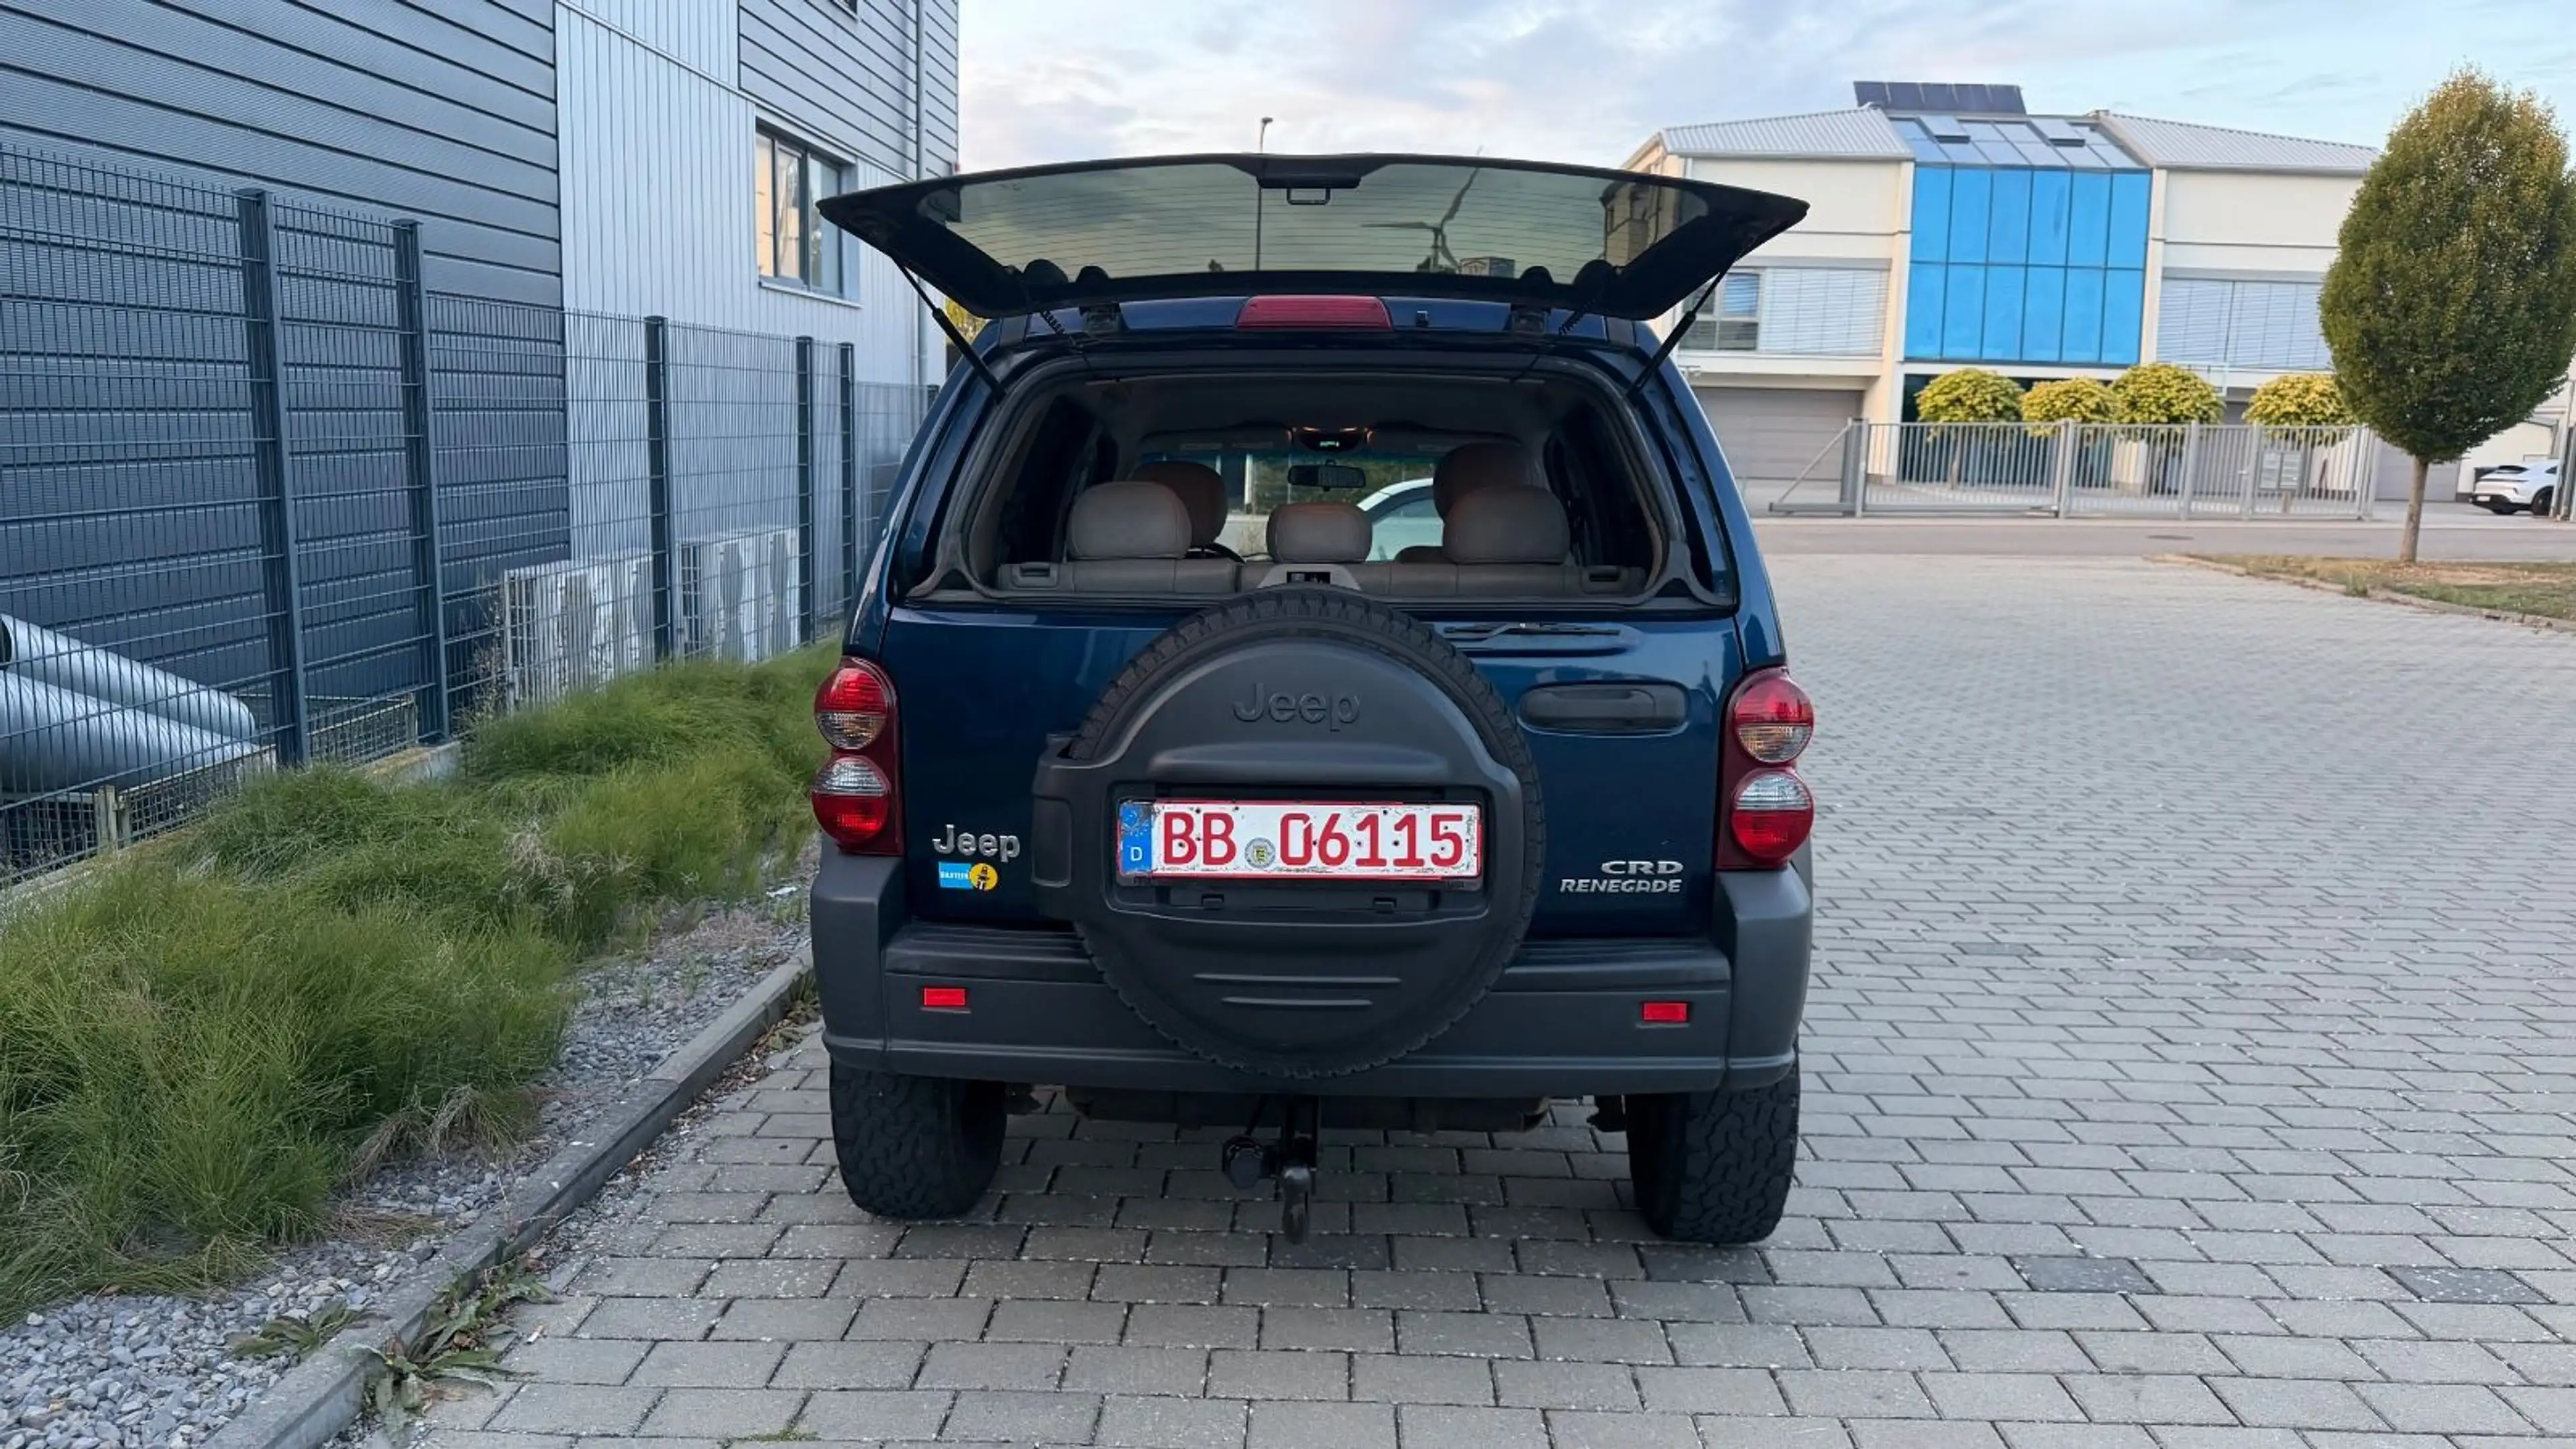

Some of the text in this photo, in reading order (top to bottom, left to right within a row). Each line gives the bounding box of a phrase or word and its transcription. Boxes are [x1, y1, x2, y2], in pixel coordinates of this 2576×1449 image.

[1233, 682, 1360, 732] Jeep
[932, 824, 1020, 863] Jeep
[1130, 812, 1464, 867] D BB 06115
[1559, 879, 1683, 894] RENEGADE
[1600, 860, 1684, 875] CRD
